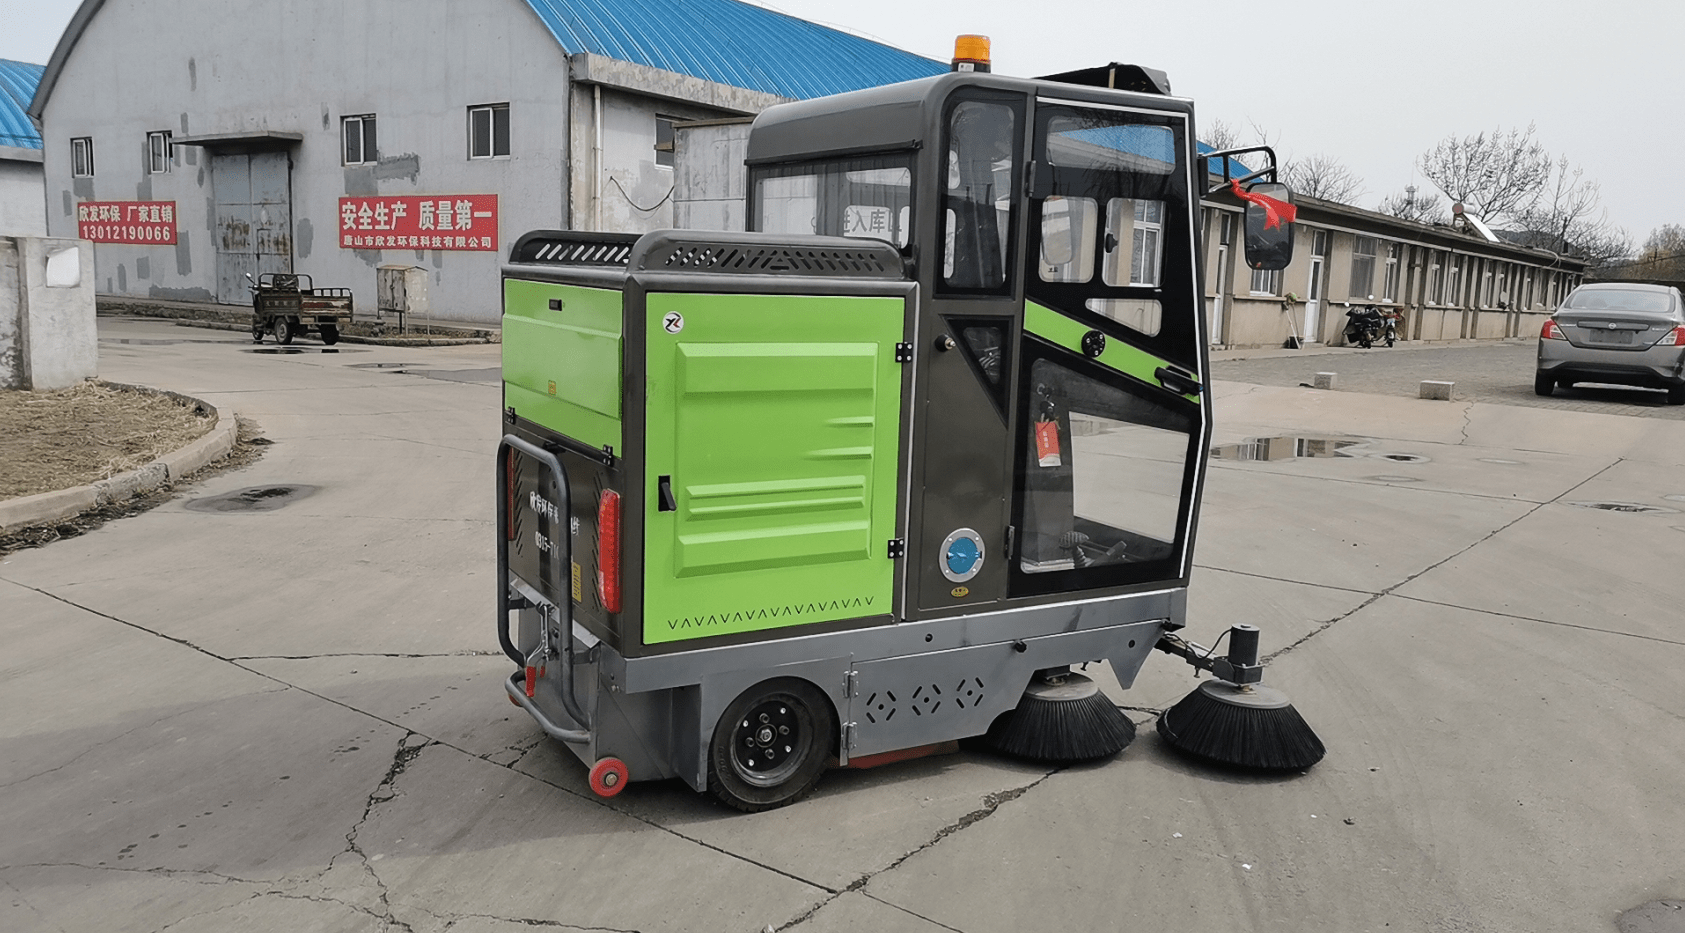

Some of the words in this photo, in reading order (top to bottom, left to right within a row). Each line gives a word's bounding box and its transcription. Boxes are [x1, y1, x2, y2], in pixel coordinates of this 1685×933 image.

[80, 205, 121, 222] 欣发环保
[127, 205, 172, 222] 厂家直销
[342, 201, 407, 230] 安全生产
[419, 200, 493, 231] 质量第一
[83, 225, 170, 241] 13012190066
[344, 235, 492, 248] 唐山市欣发环保科技有限公司
